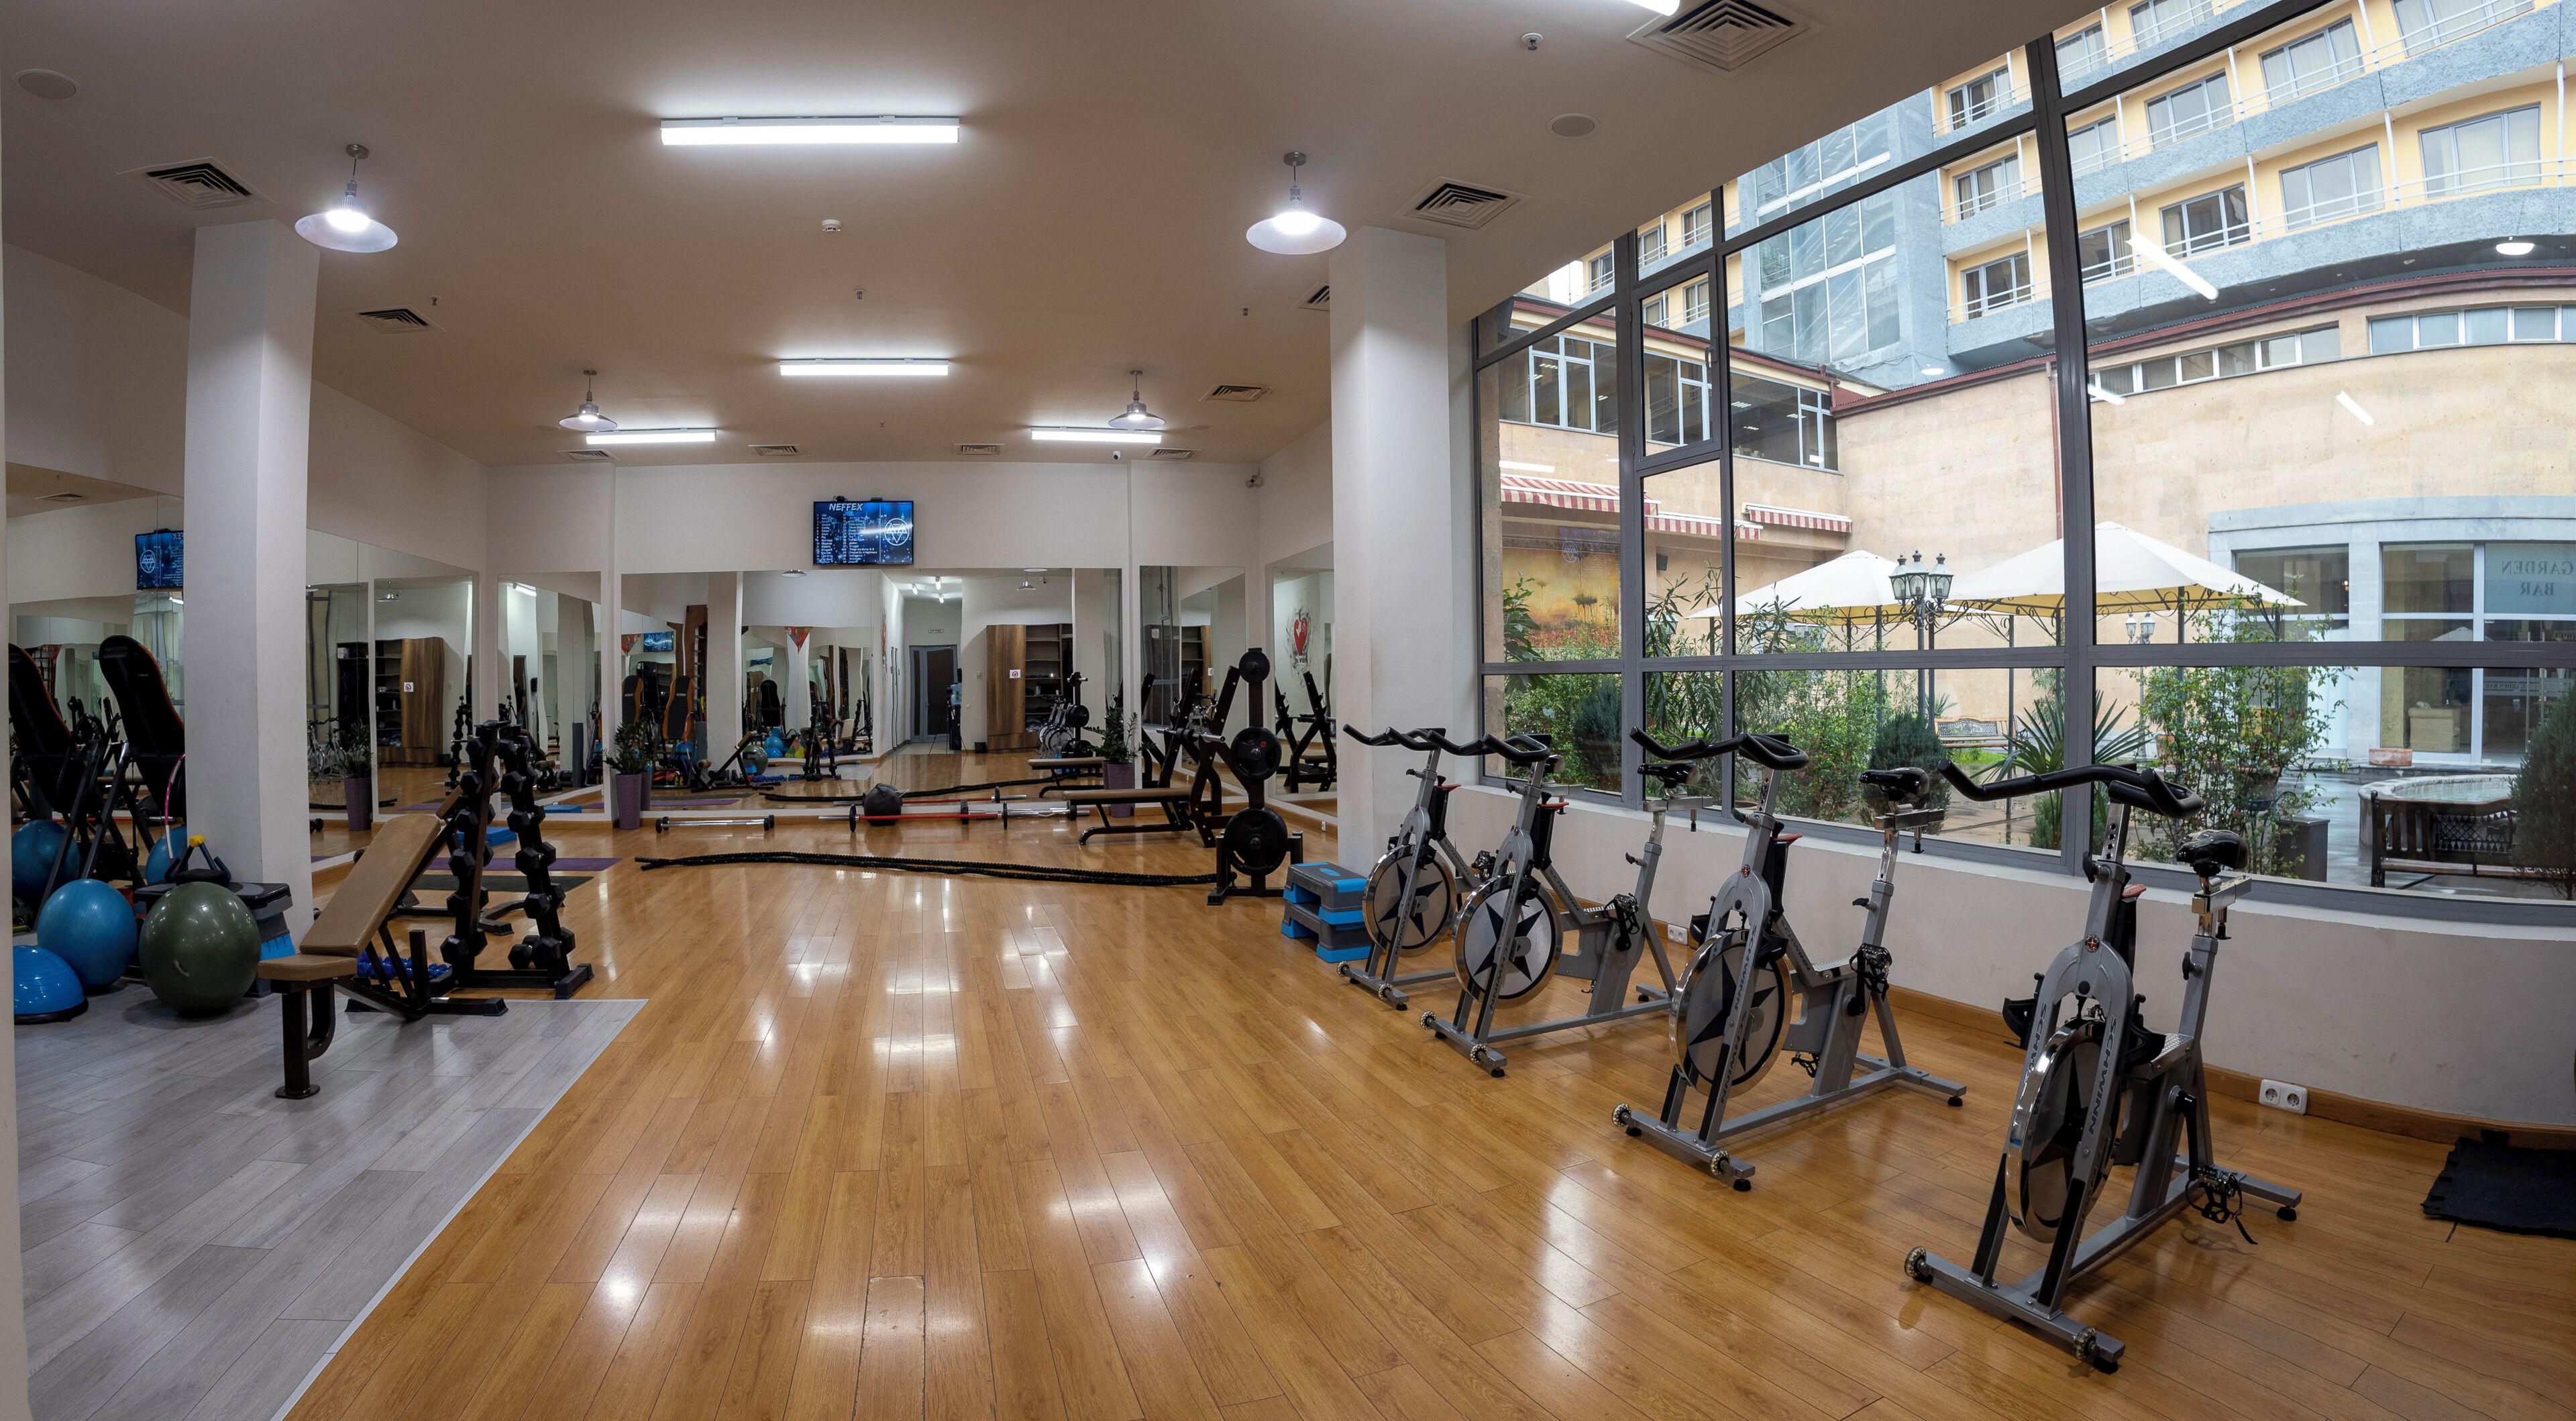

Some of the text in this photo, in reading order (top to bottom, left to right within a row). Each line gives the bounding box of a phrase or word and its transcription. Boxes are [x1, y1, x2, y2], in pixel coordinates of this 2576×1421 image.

[829, 503, 863, 512] NEFFEX
[1549, 868, 1580, 912] SCHWINN
[1395, 894, 1413, 956] SCHWINN
[1780, 918, 1812, 971] SCHWINN
[1489, 935, 1511, 1011] SCHWINN
[1735, 923, 1757, 1011] SCHWINN
[1719, 1008, 1748, 1106] SCHWINN
[2089, 1015, 2117, 1136] SCHWINN
